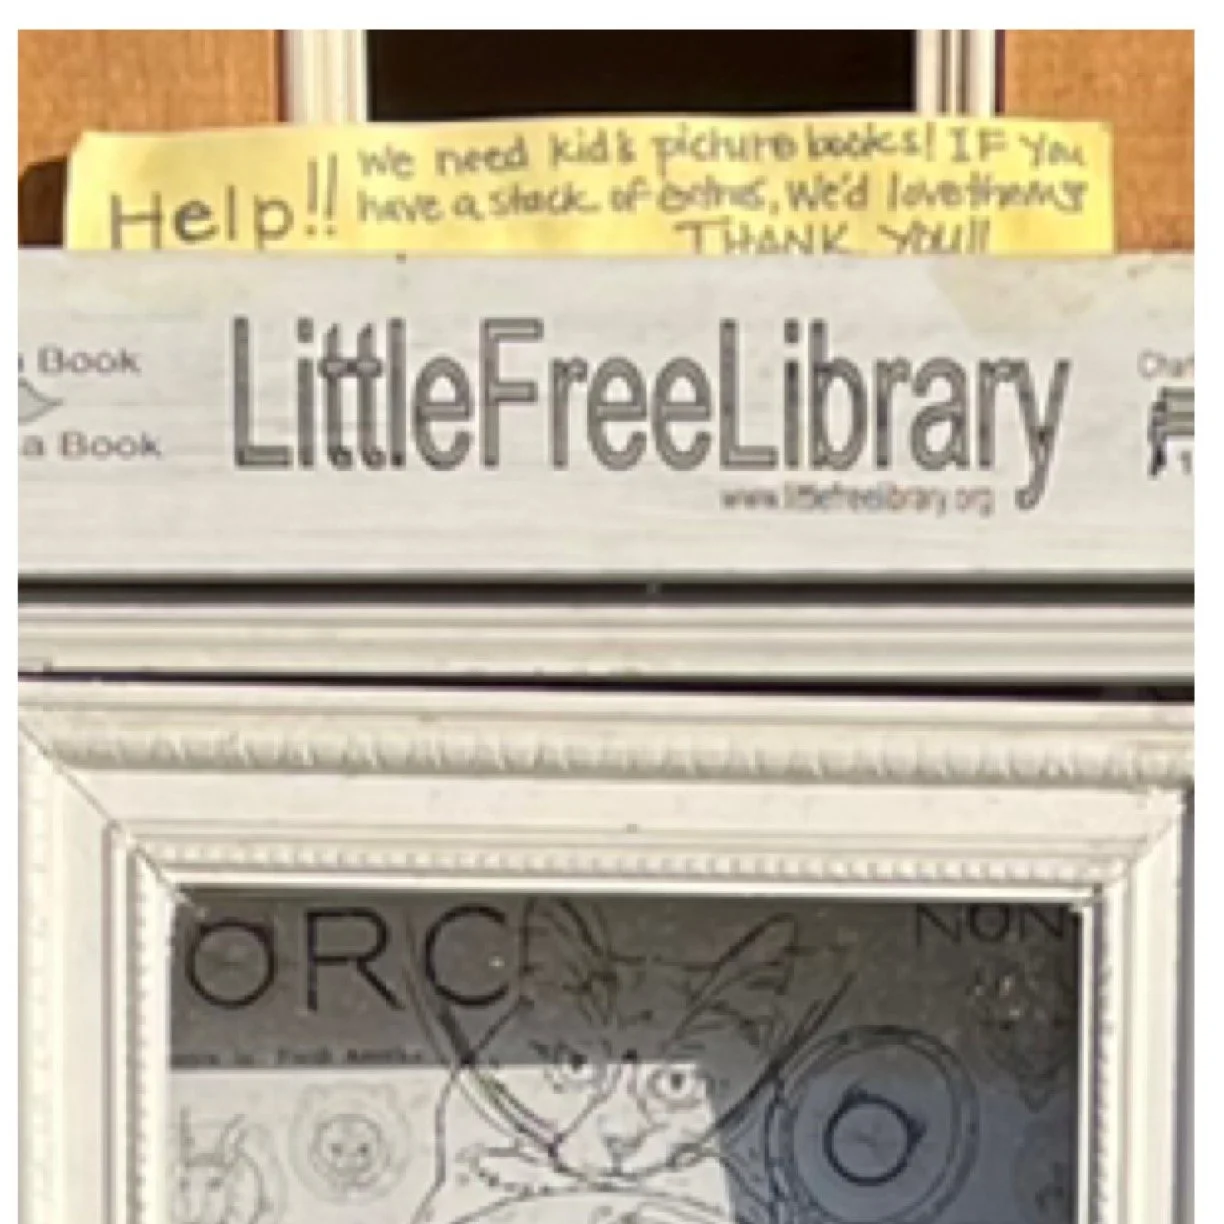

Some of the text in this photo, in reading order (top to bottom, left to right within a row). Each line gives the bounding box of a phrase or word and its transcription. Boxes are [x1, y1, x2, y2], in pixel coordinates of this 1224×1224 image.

[357, 146, 415, 179] We
[435, 133, 529, 177] need
[651, 122, 799, 177] picture
[807, 121, 935, 162] books!
[110, 155, 338, 250] Help!!
[357, 189, 442, 222] have
[452, 191, 481, 220] a
[489, 181, 601, 218] stack
[610, 175, 650, 213] of
[676, 215, 849, 253] THANK
[37, 345, 142, 376] Book
[232, 316, 1071, 511] LittleFreeLibrary
[22, 429, 163, 459] a Book
[914, 903, 1066, 948] NON
[185, 902, 511, 1012] ORC
